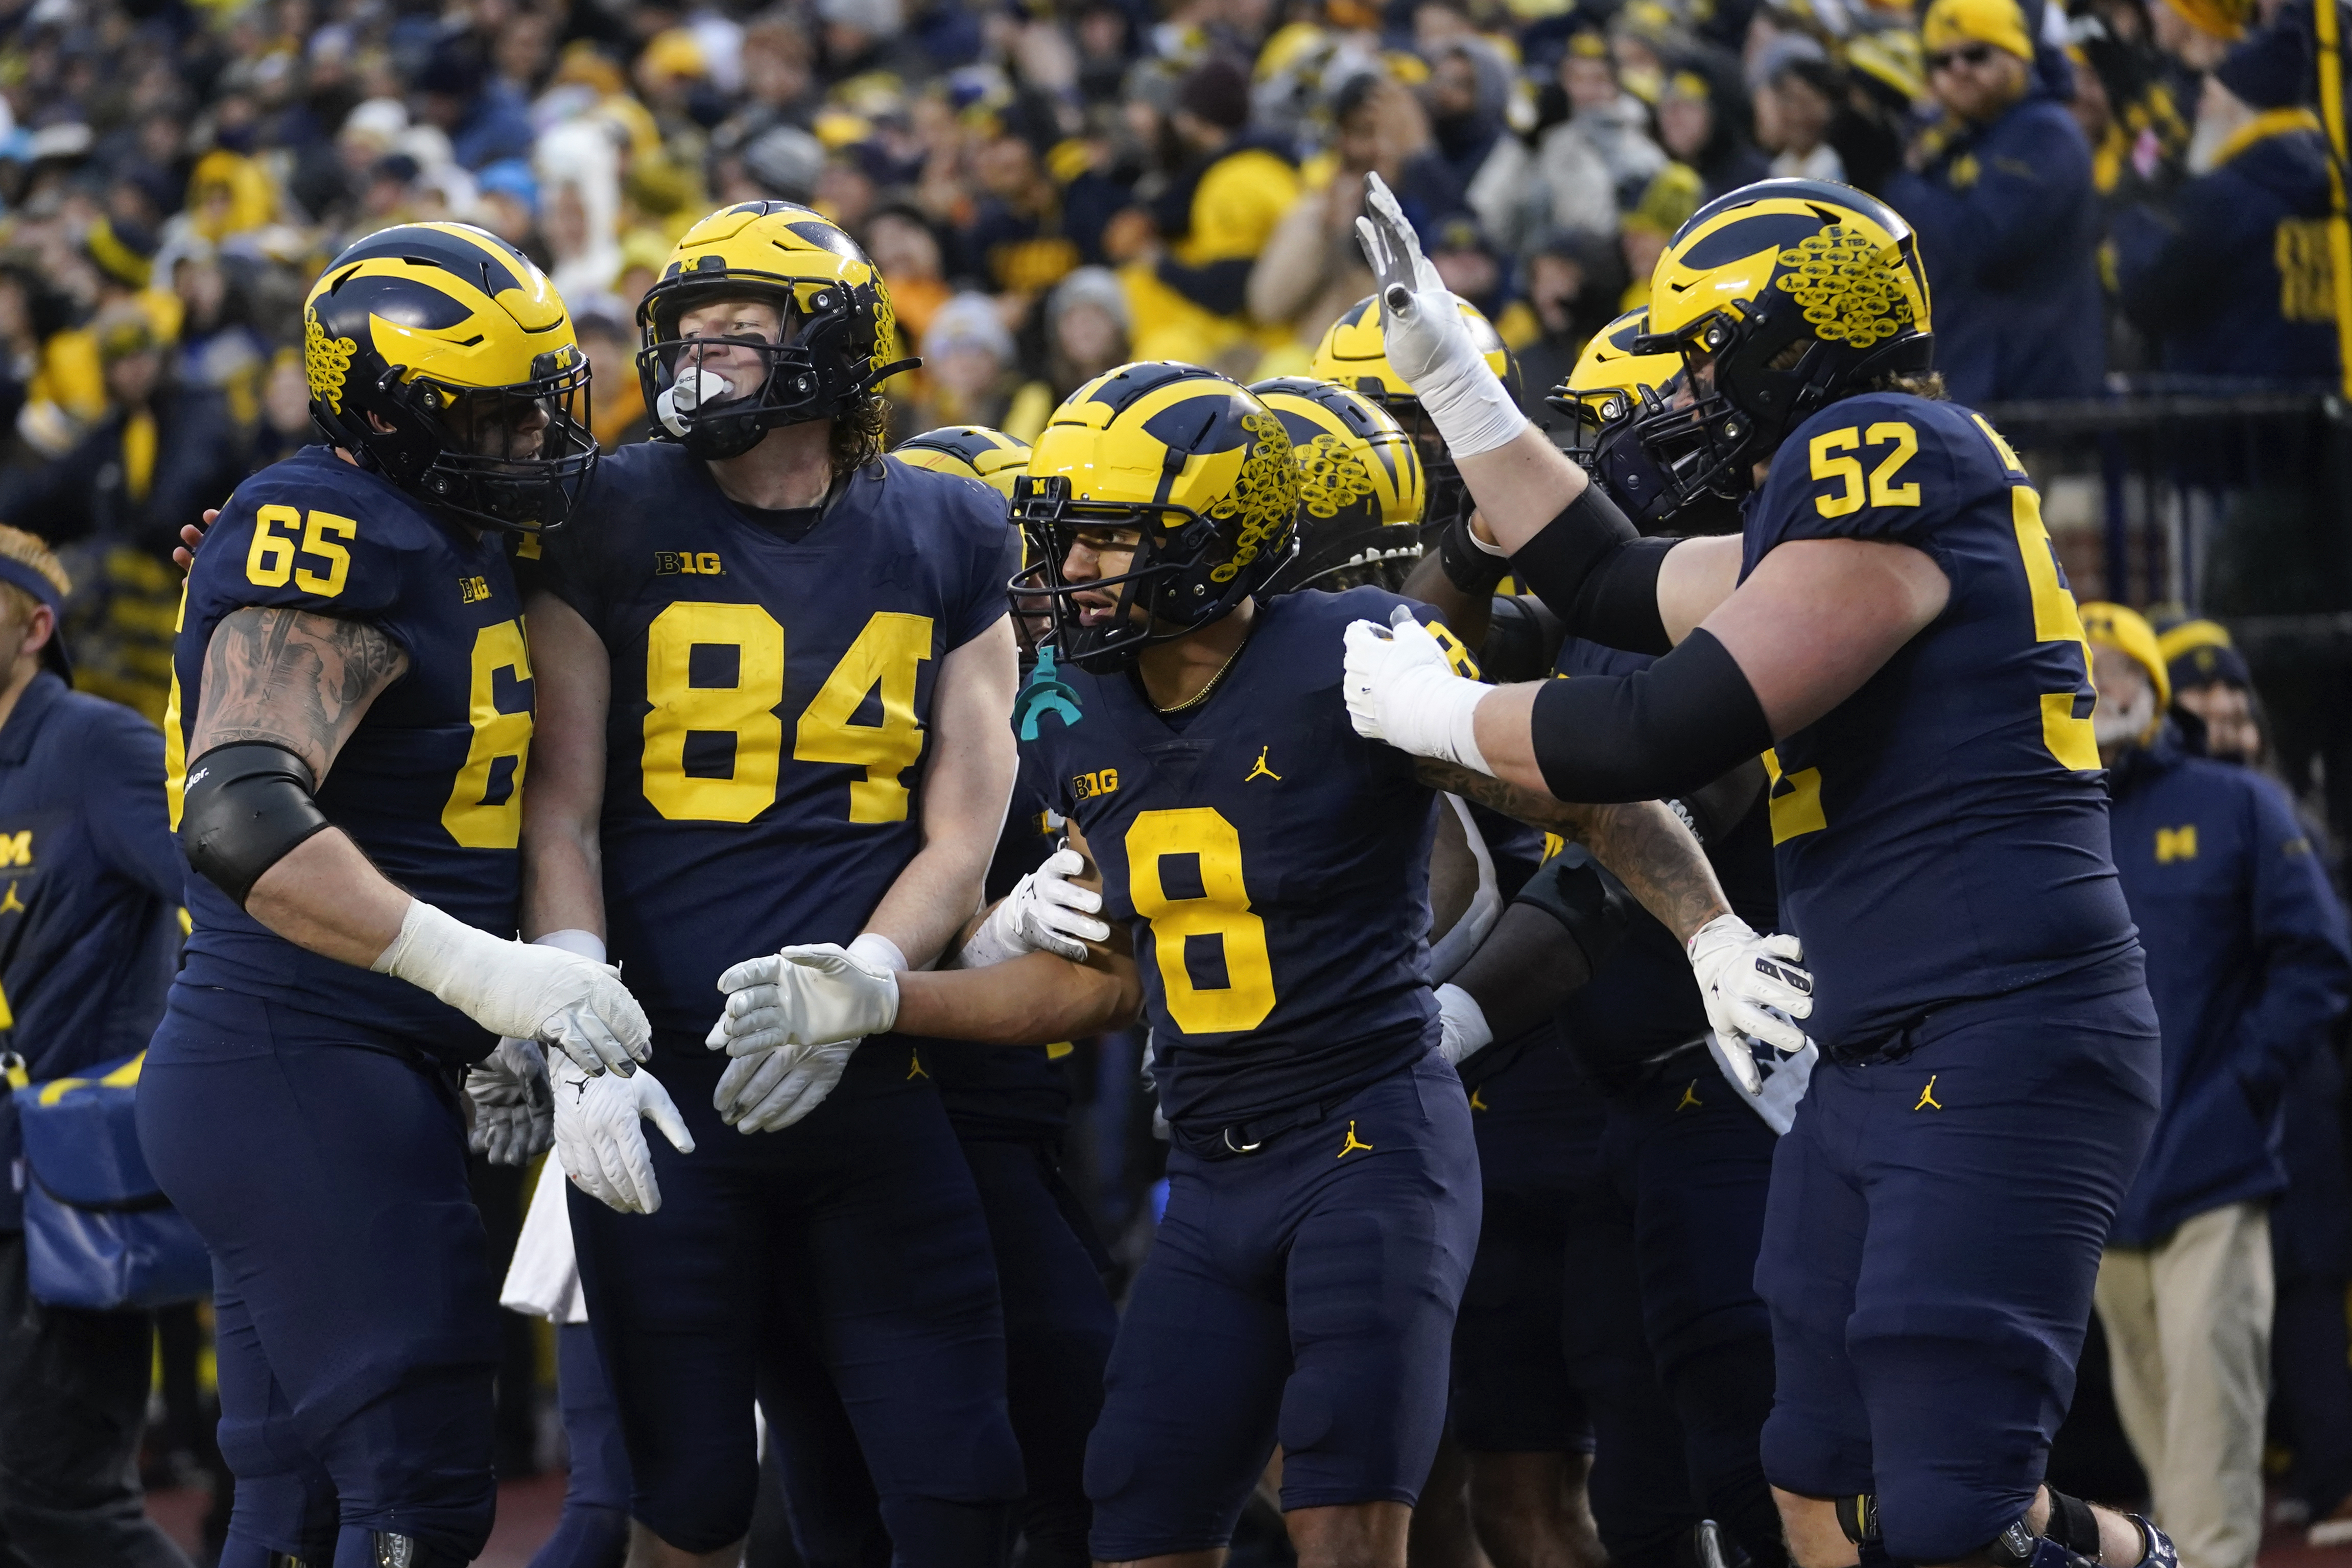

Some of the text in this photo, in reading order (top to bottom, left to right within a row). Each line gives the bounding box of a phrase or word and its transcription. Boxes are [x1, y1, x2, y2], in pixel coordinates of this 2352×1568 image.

[679, 257, 702, 273] M
[1895, 304, 1912, 324] 52
[555, 349, 572, 369] M
[679, 375, 696, 384] SHOC
[1032, 478, 1046, 495] M
[1810, 422, 1921, 519] 52
[246, 504, 357, 599] 65
[441, 614, 537, 849] 6
[642, 601, 934, 823] 84
[0, 830, 32, 867] M
[2155, 824, 2198, 865] M
[1125, 806, 1276, 1034] 8
